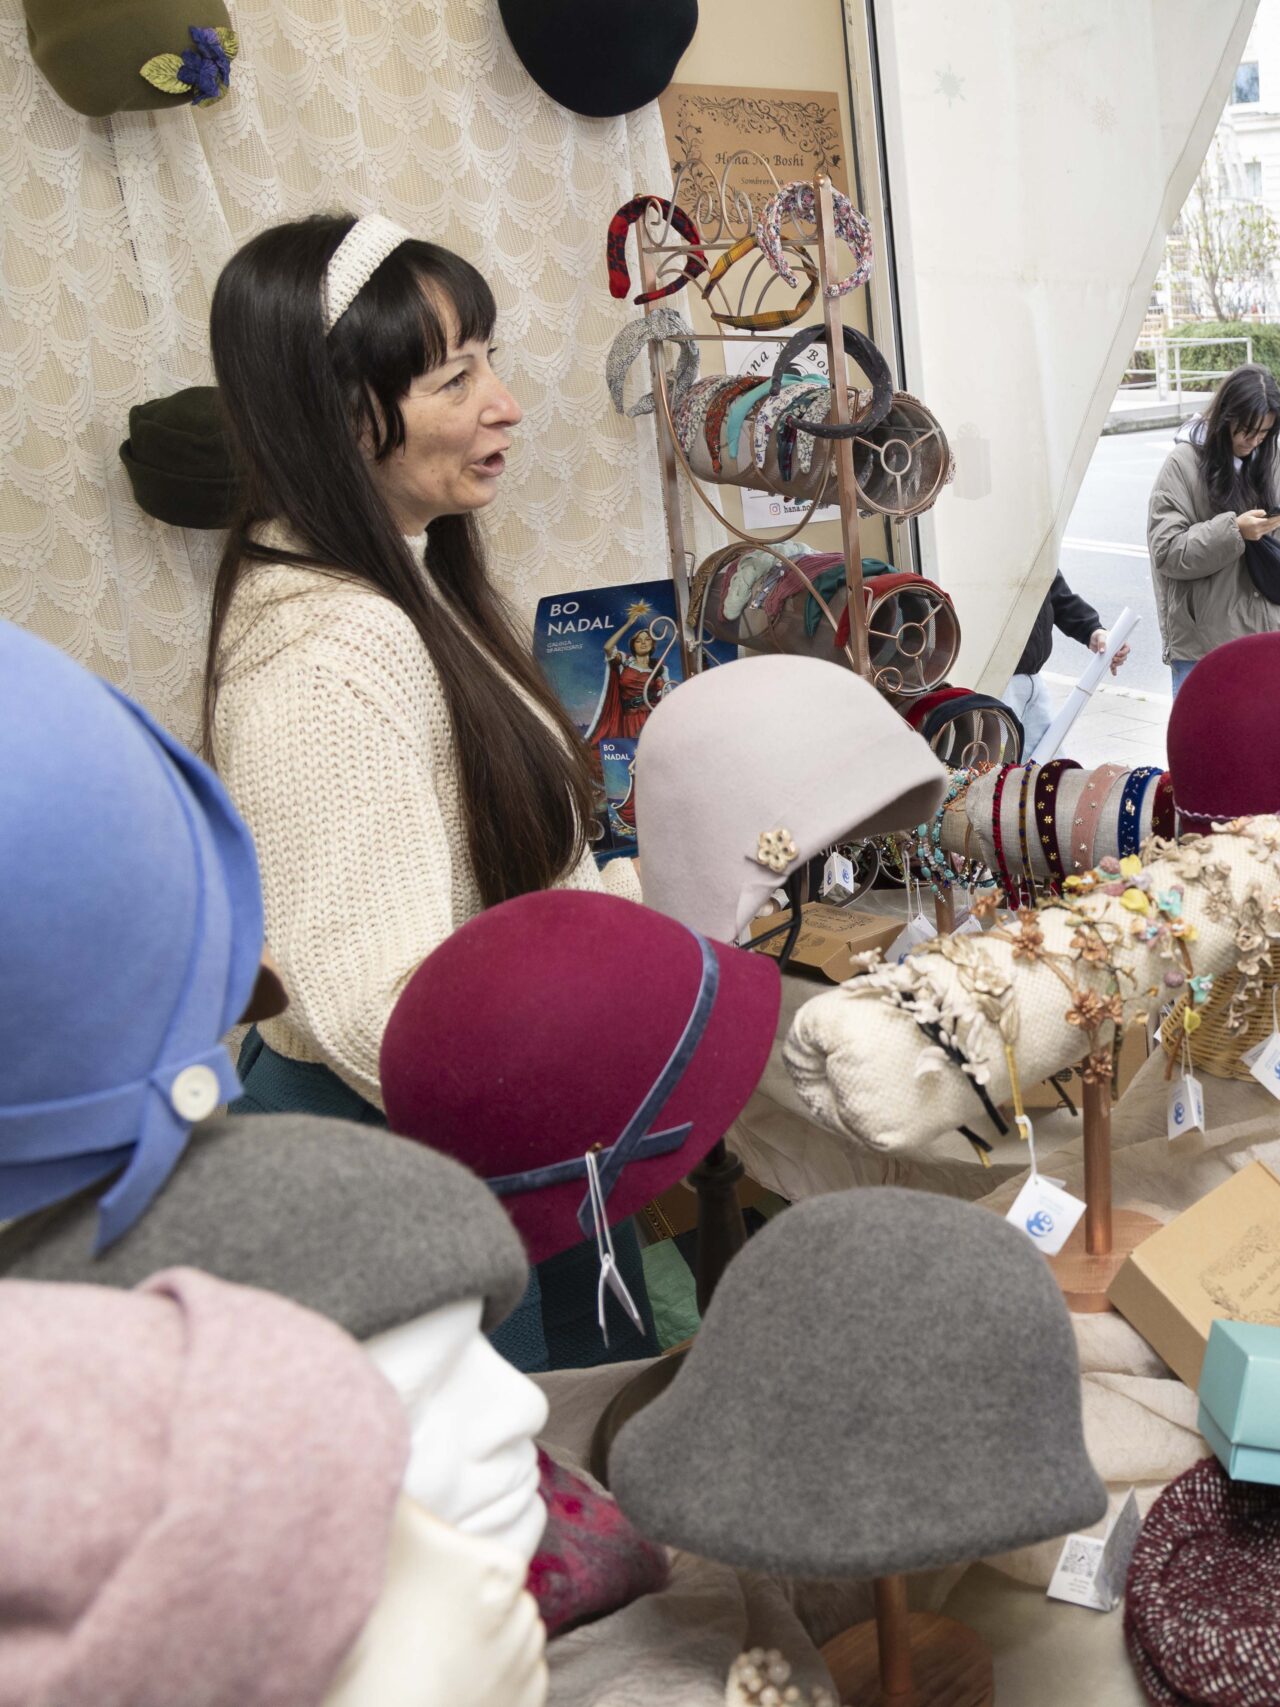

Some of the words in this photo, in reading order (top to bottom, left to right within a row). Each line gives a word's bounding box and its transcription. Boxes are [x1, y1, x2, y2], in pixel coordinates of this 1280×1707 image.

[773, 155, 804, 166] Boshi
[550, 601, 579, 617] BO
[547, 615, 614, 636] NADAL
[604, 753, 630, 761] NADAL
